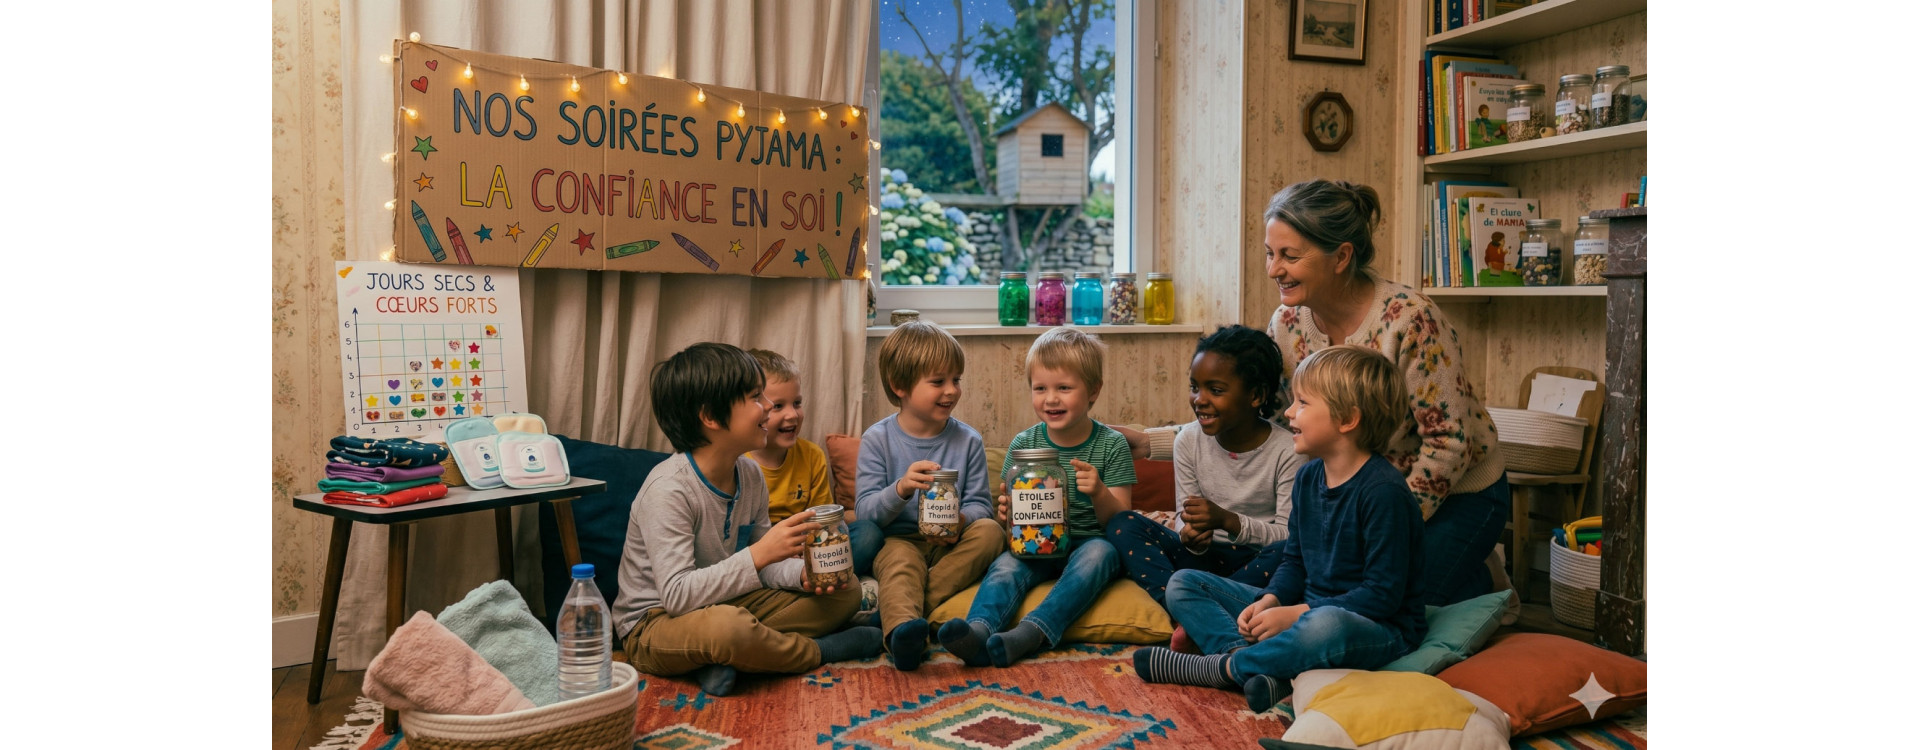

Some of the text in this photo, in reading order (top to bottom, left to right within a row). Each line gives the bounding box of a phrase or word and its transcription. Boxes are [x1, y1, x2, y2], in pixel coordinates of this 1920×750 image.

[453, 88, 538, 141] NOS
[717, 121, 826, 172] PYJAMA
[834, 144, 842, 165] :
[460, 162, 513, 210] LA
[732, 186, 768, 229] EN
[834, 191, 844, 239] !
[1483, 218, 1494, 226] de
[366, 272, 496, 292] JOURS SECS &
[376, 296, 498, 314] CŒURS FORTS
[1019, 491, 1055, 501] ÉTOILES
[1031, 502, 1043, 510] DE
[1013, 511, 1062, 521] CONFIANCE
[813, 547, 843, 560] Léopold
[819, 557, 848, 568] Thomas
